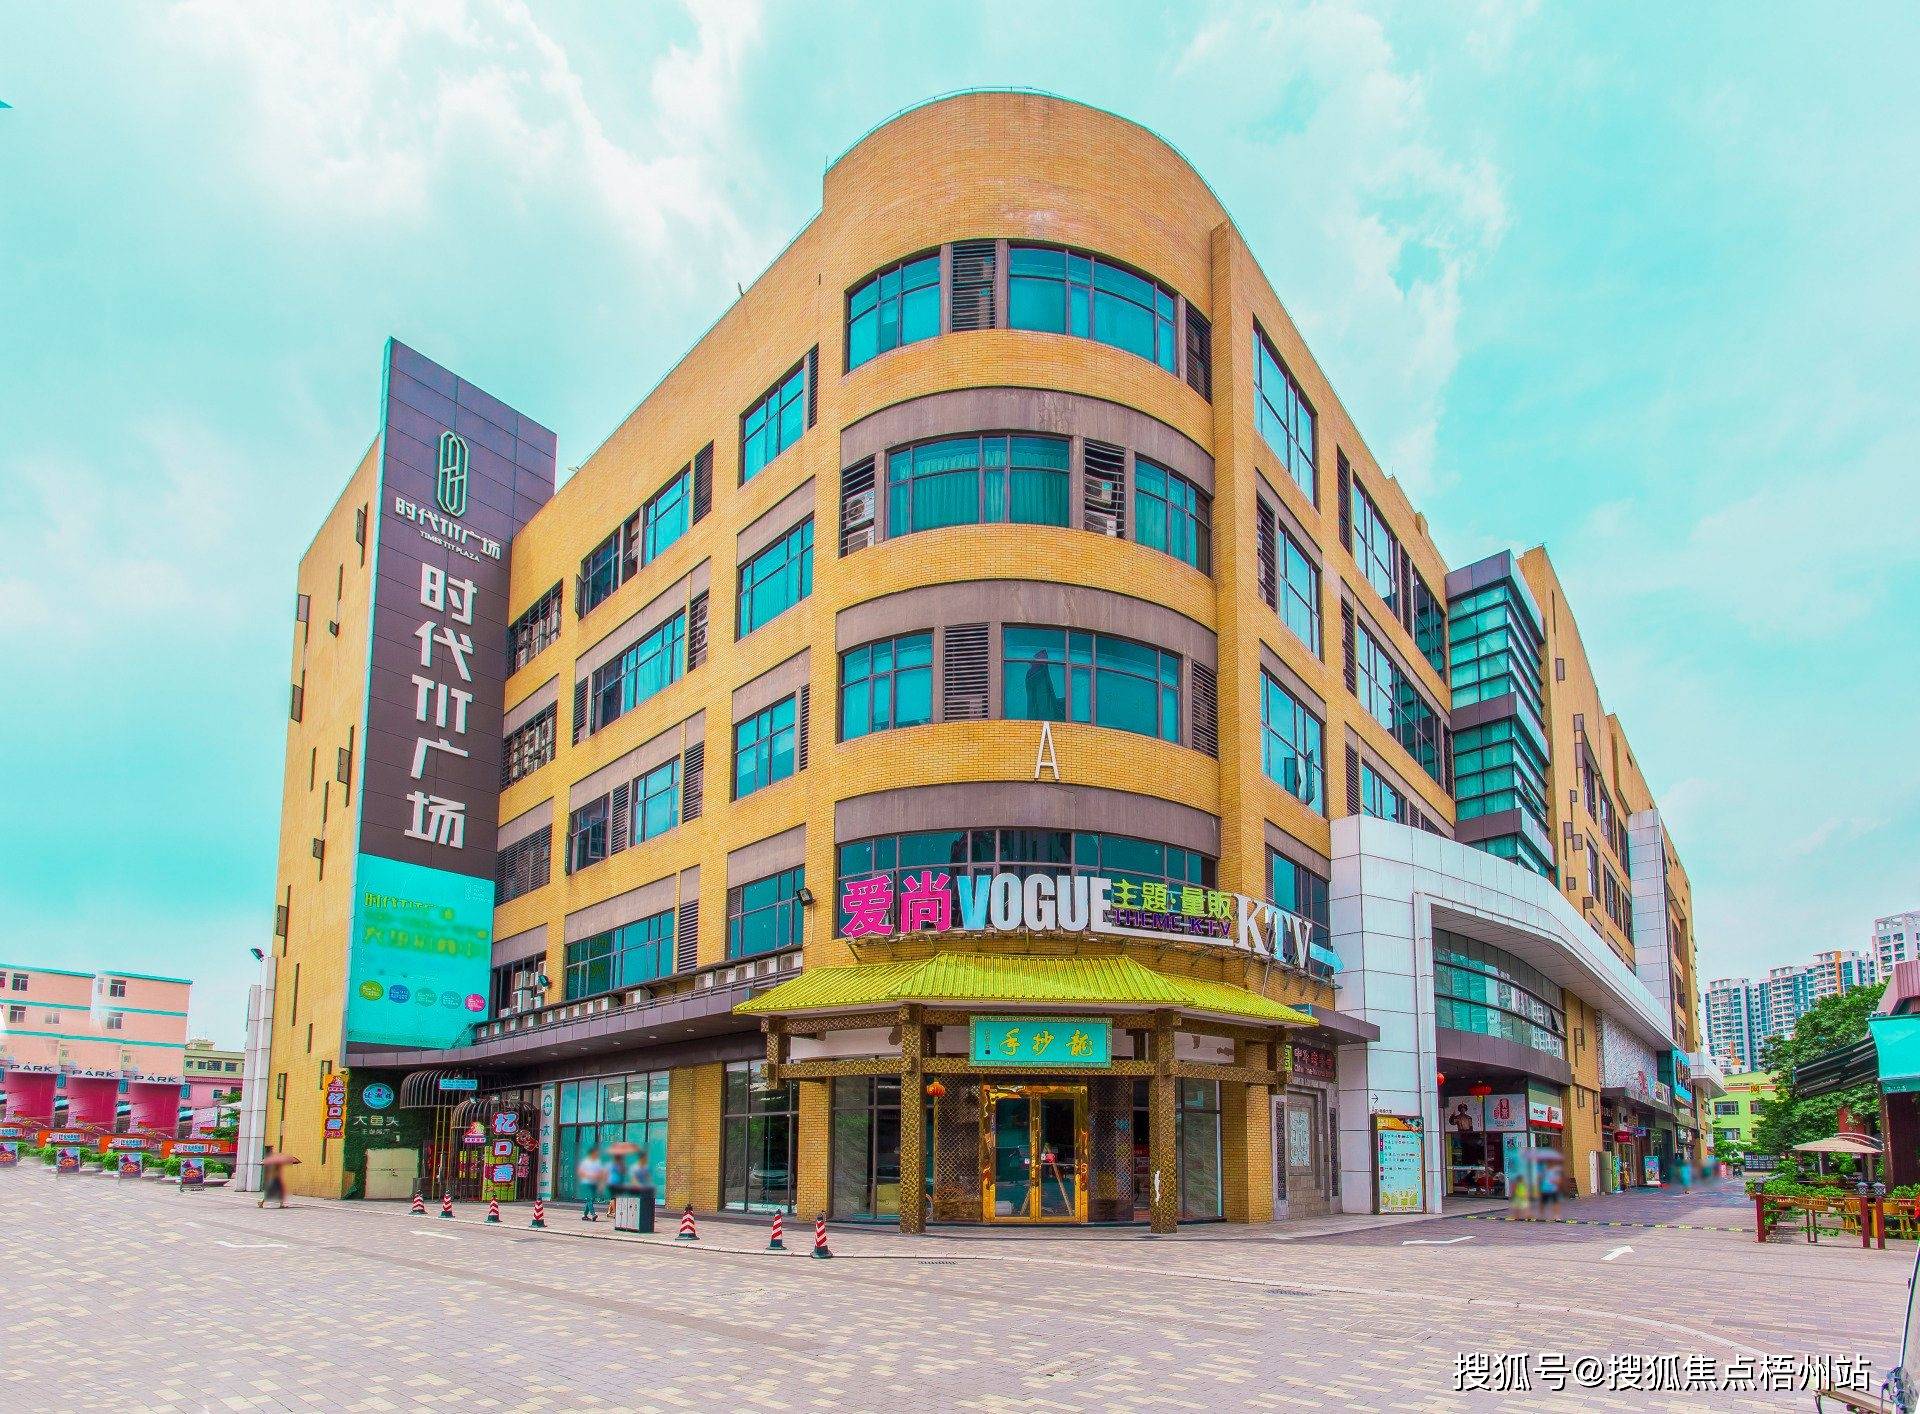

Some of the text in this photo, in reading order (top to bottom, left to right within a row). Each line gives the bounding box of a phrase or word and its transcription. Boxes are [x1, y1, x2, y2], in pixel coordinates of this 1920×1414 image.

[1034, 720, 1059, 780] A
[841, 870, 1112, 938] 爱尚 VOGUE
[1113, 908, 1232, 937] THEME KTV
[1233, 892, 1313, 969] KTV
[10, 1064, 53, 1073] PARK
[72, 1069, 116, 1078] PARK
[134, 1075, 178, 1083] PARK
[353, 1114, 399, 1126] 大鱼头
